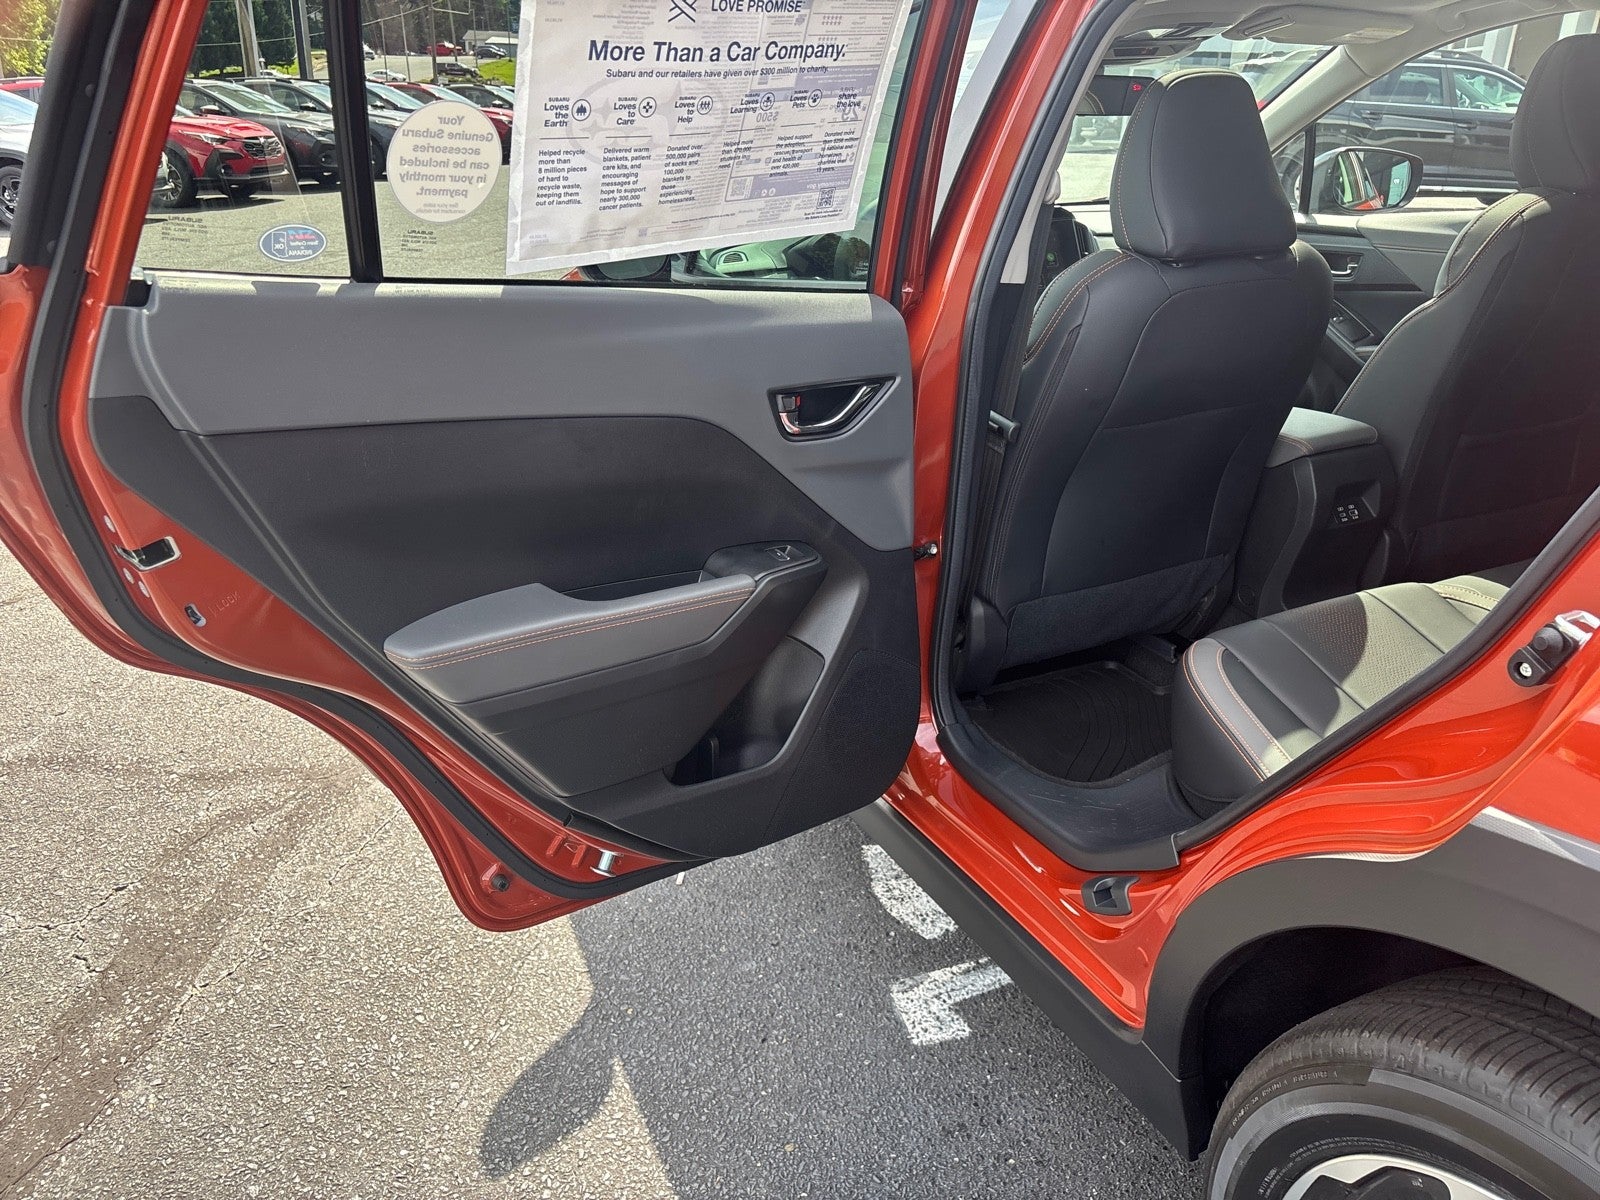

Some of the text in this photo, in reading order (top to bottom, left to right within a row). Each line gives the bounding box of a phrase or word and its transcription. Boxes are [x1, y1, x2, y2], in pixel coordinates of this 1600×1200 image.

[712, 0, 802, 13] LOVE PROMISE
[588, 40, 645, 61] More
[653, 41, 704, 62] Than
[709, 47, 720, 62] a
[727, 41, 760, 62] Car
[606, 68, 636, 78] Subaru
[638, 69, 653, 78] and
[671, 69, 702, 78] retailers
[704, 69, 722, 78] have
[723, 69, 742, 79] given
[760, 67, 775, 75] $300
[776, 66, 797, 74] million
[807, 66, 828, 74] charity.
[544, 103, 569, 111] Loves
[538, 149, 585, 157] Helped recycle
[567, 166, 587, 174] pieces
[602, 171, 638, 179] encouraging
